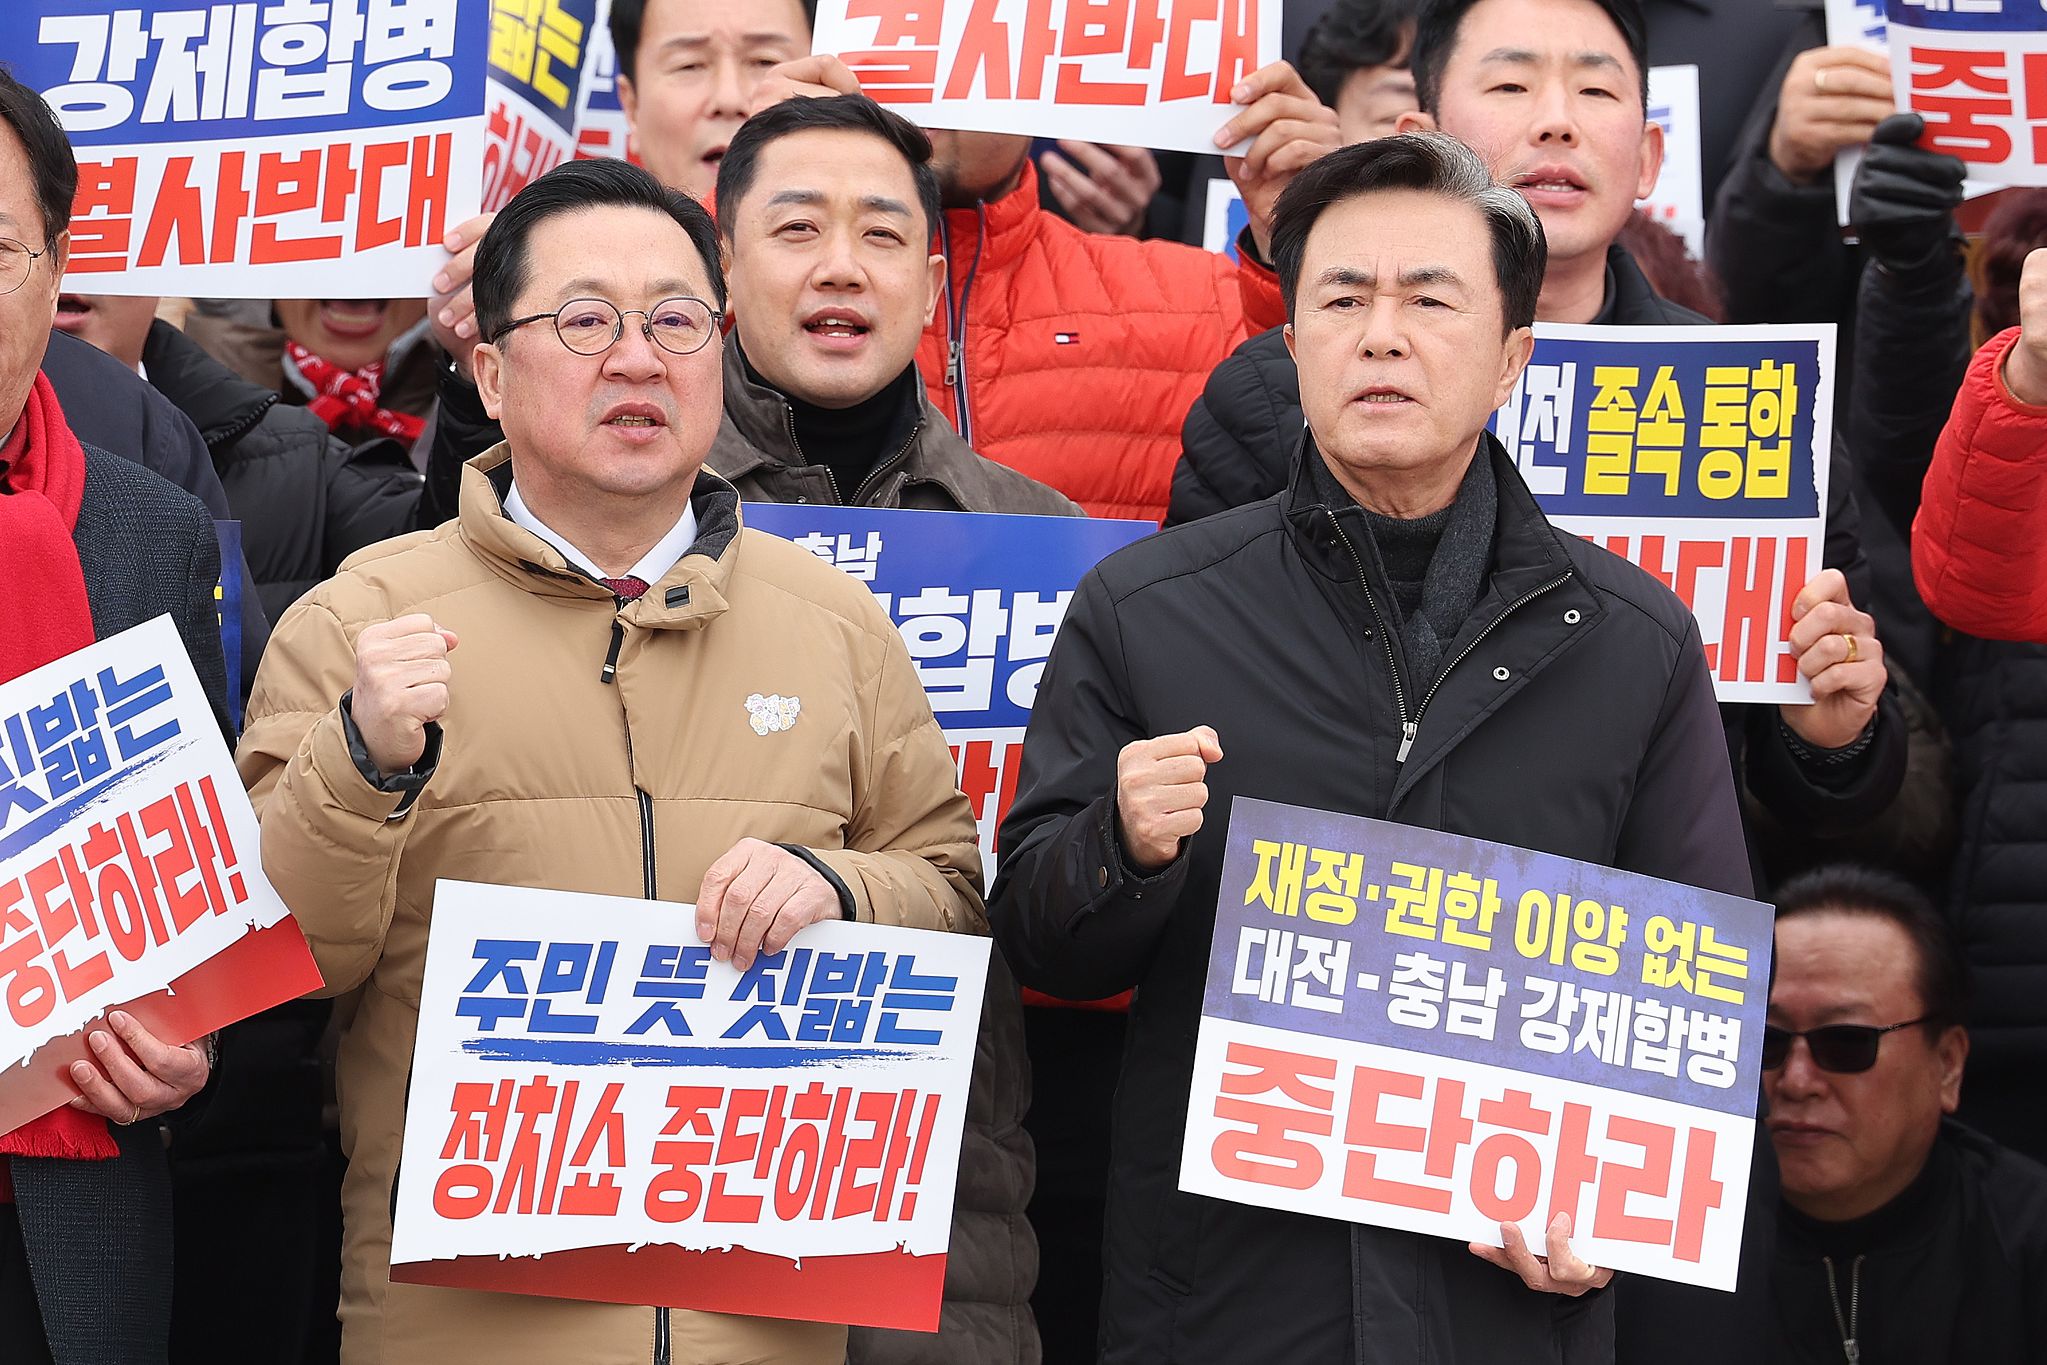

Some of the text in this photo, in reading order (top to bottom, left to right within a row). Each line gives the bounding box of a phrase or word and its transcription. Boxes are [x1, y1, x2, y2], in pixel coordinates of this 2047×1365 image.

[38, 0, 457, 131] 강제합병
[837, 0, 1258, 105] 결사반대
[1910, 46, 2047, 164] 중
[1583, 365, 1685, 496] 졸속
[1697, 359, 1798, 500] 통합
[0, 774, 249, 1029] 중단하라!
[1514, 888, 1628, 977] 이양
[1641, 914, 1749, 1006] 없는
[455, 939, 959, 1046] 주민 뜻 짓밟는
[1519, 975, 1743, 1089] 강제합병
[432, 1075, 943, 1225] 정치쇼 중단하라!
[1210, 1041, 1724, 1264] 중단하라
